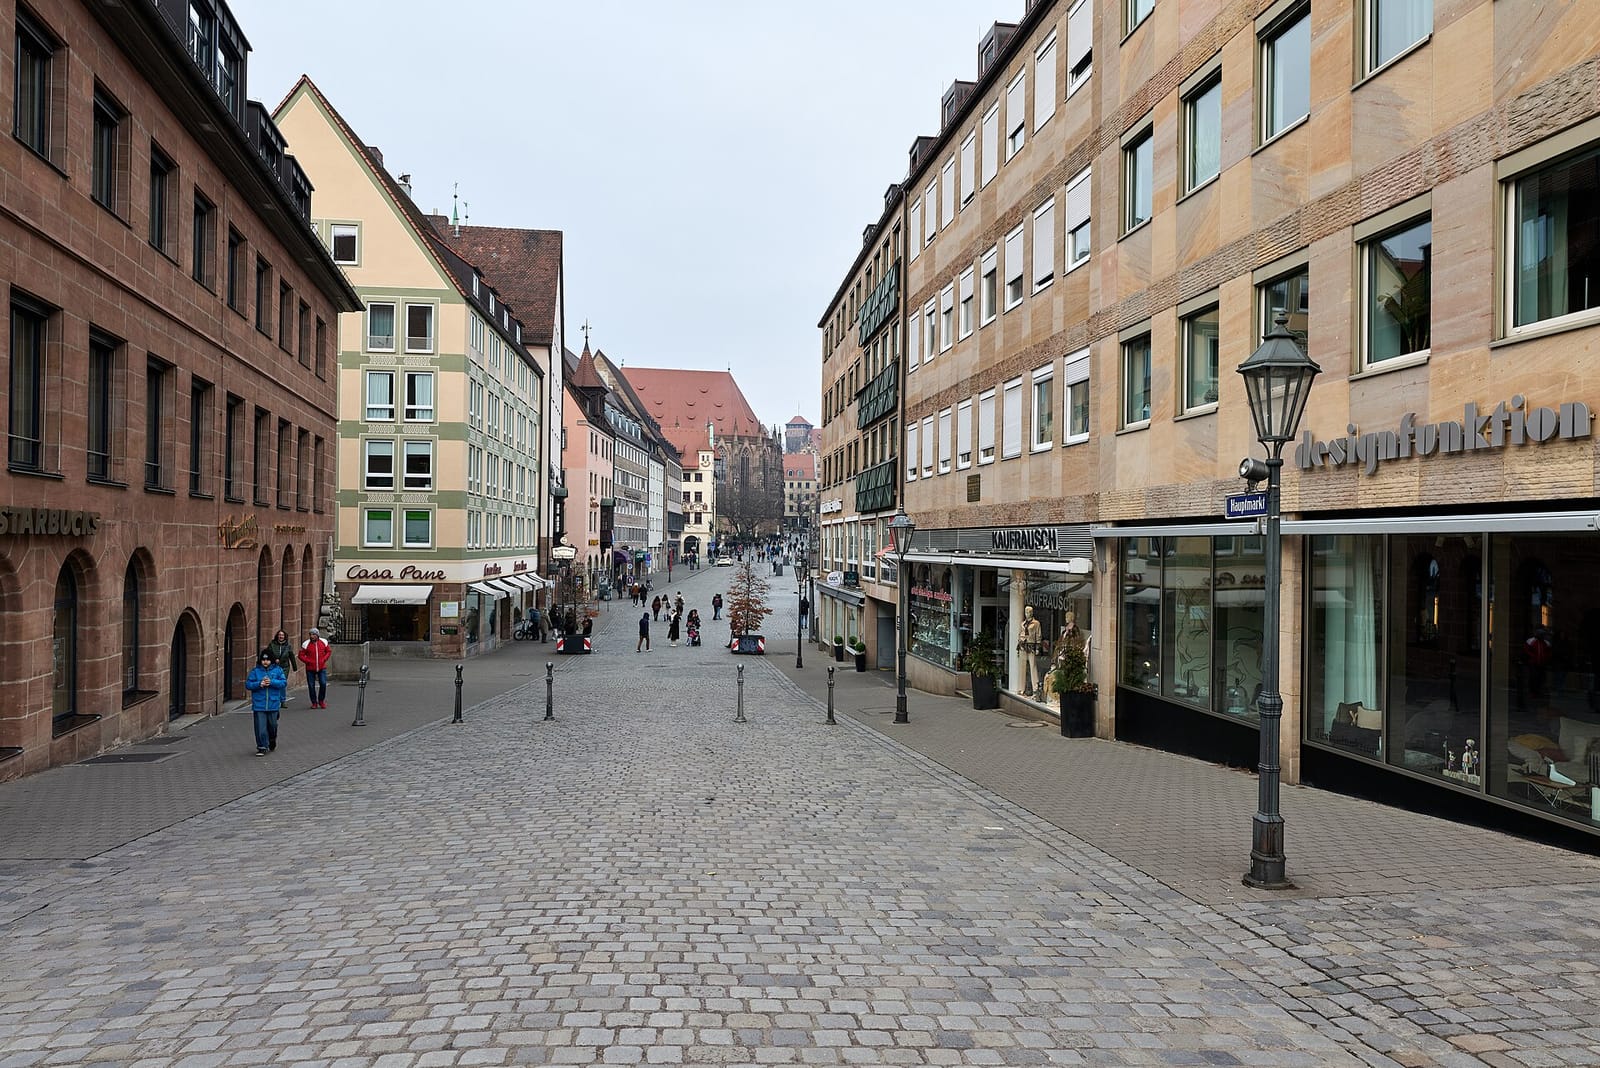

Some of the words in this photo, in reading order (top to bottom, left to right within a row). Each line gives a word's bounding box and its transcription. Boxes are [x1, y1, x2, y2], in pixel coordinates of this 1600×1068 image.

[1294, 394, 1592, 476] designfunktion
[1230, 495, 1266, 514] Hauptmarkt
[0, 506, 100, 536] STARBUCKS
[992, 528, 1059, 550] KAUFRAUSCH
[346, 564, 394, 580] Casa
[400, 565, 447, 580] Pane
[1025, 591, 1074, 612] KAUFRAUSCH
